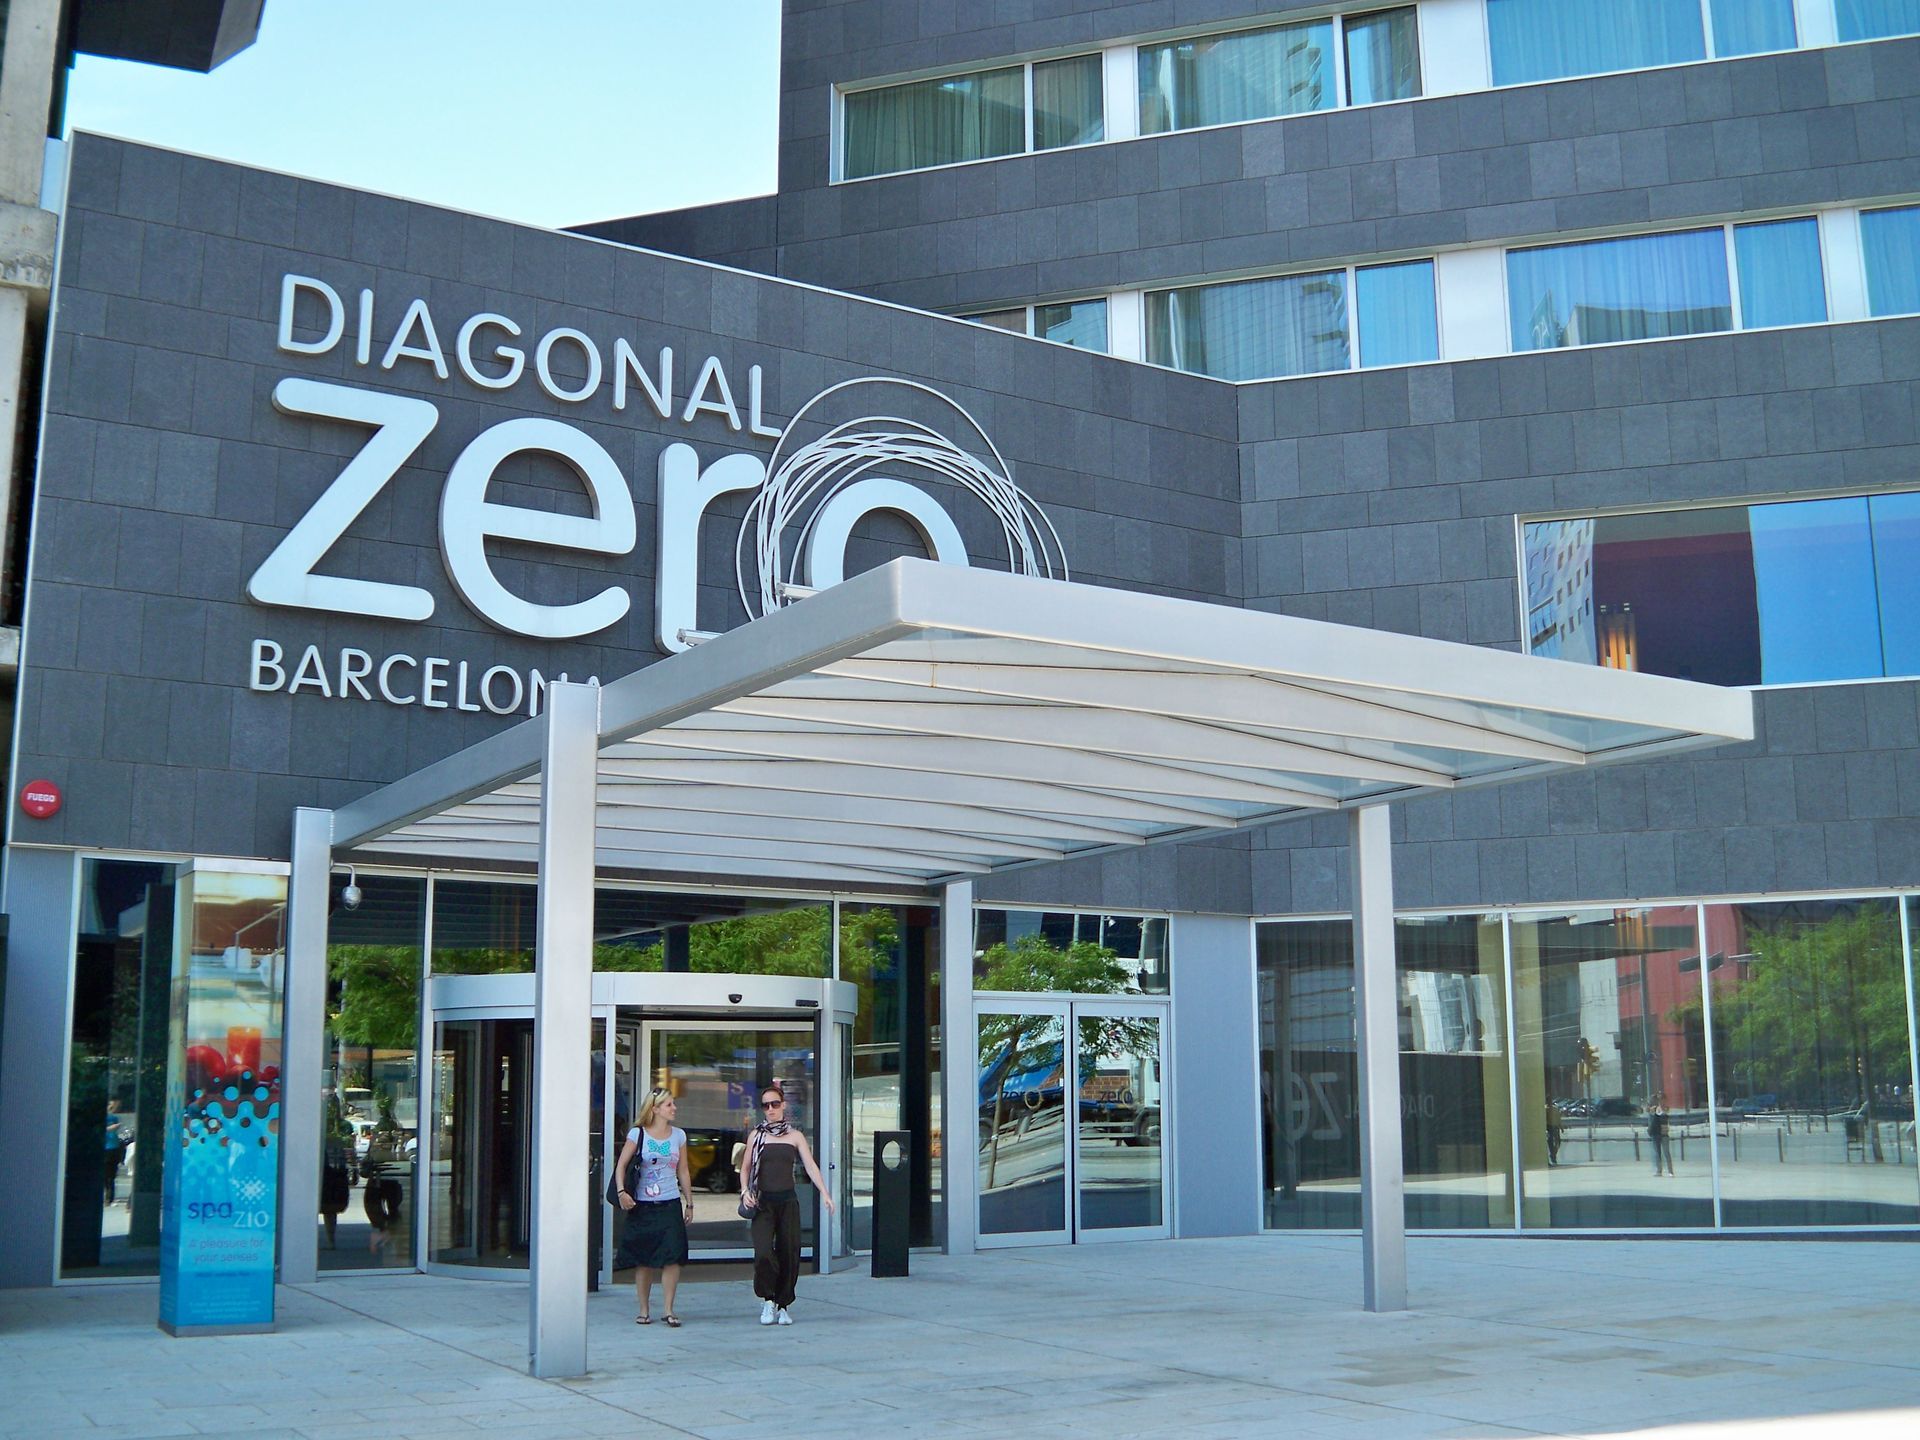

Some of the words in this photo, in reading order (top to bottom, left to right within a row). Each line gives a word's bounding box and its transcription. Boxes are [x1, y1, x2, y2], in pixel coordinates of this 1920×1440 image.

[278, 273, 782, 437] DIAGONAL
[250, 638, 600, 717] BARCELON
[26, 792, 56, 803] FUEGO
[1100, 1089, 1134, 1103] zero
[188, 1202, 232, 1225] spa
[200, 1238, 248, 1249] pleasure
[250, 1236, 264, 1248] for
[194, 1253, 217, 1265] your
[222, 1253, 258, 1262] senses
